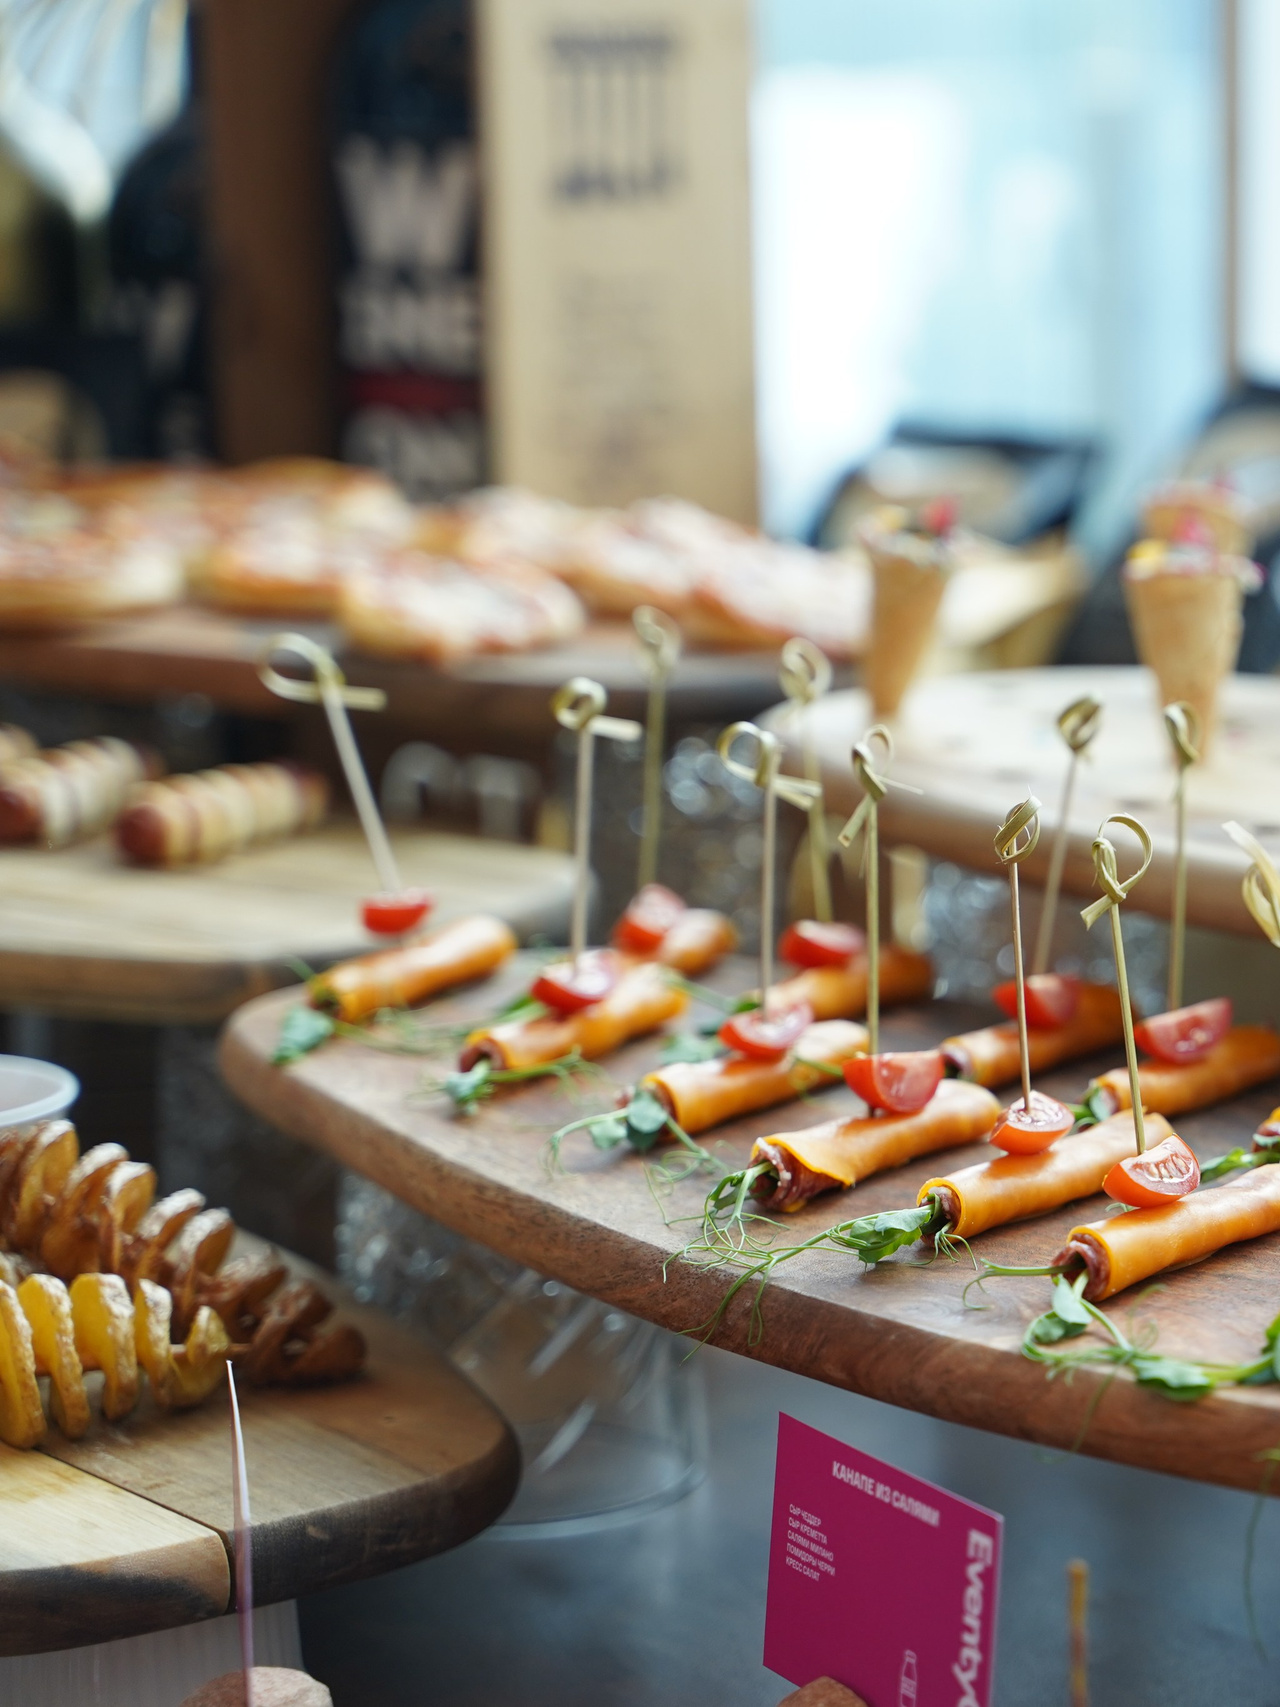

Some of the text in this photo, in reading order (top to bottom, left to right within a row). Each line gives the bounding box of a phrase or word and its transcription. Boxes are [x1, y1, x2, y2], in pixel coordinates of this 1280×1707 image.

[832, 1461, 940, 1528] КАНАПЕ ИЗ САЛЯМИ
[789, 1503, 822, 1527] СЫР ЧЕДДЕР
[788, 1516, 828, 1545] СЫР КРЕМЕТТА
[786, 1542, 836, 1576] ПОМИДОРЫ ЧЕРРИ
[787, 1530, 834, 1562] САЛЯМИ МИЛАНО
[785, 1555, 820, 1581] КРЕСС САЛАТ
